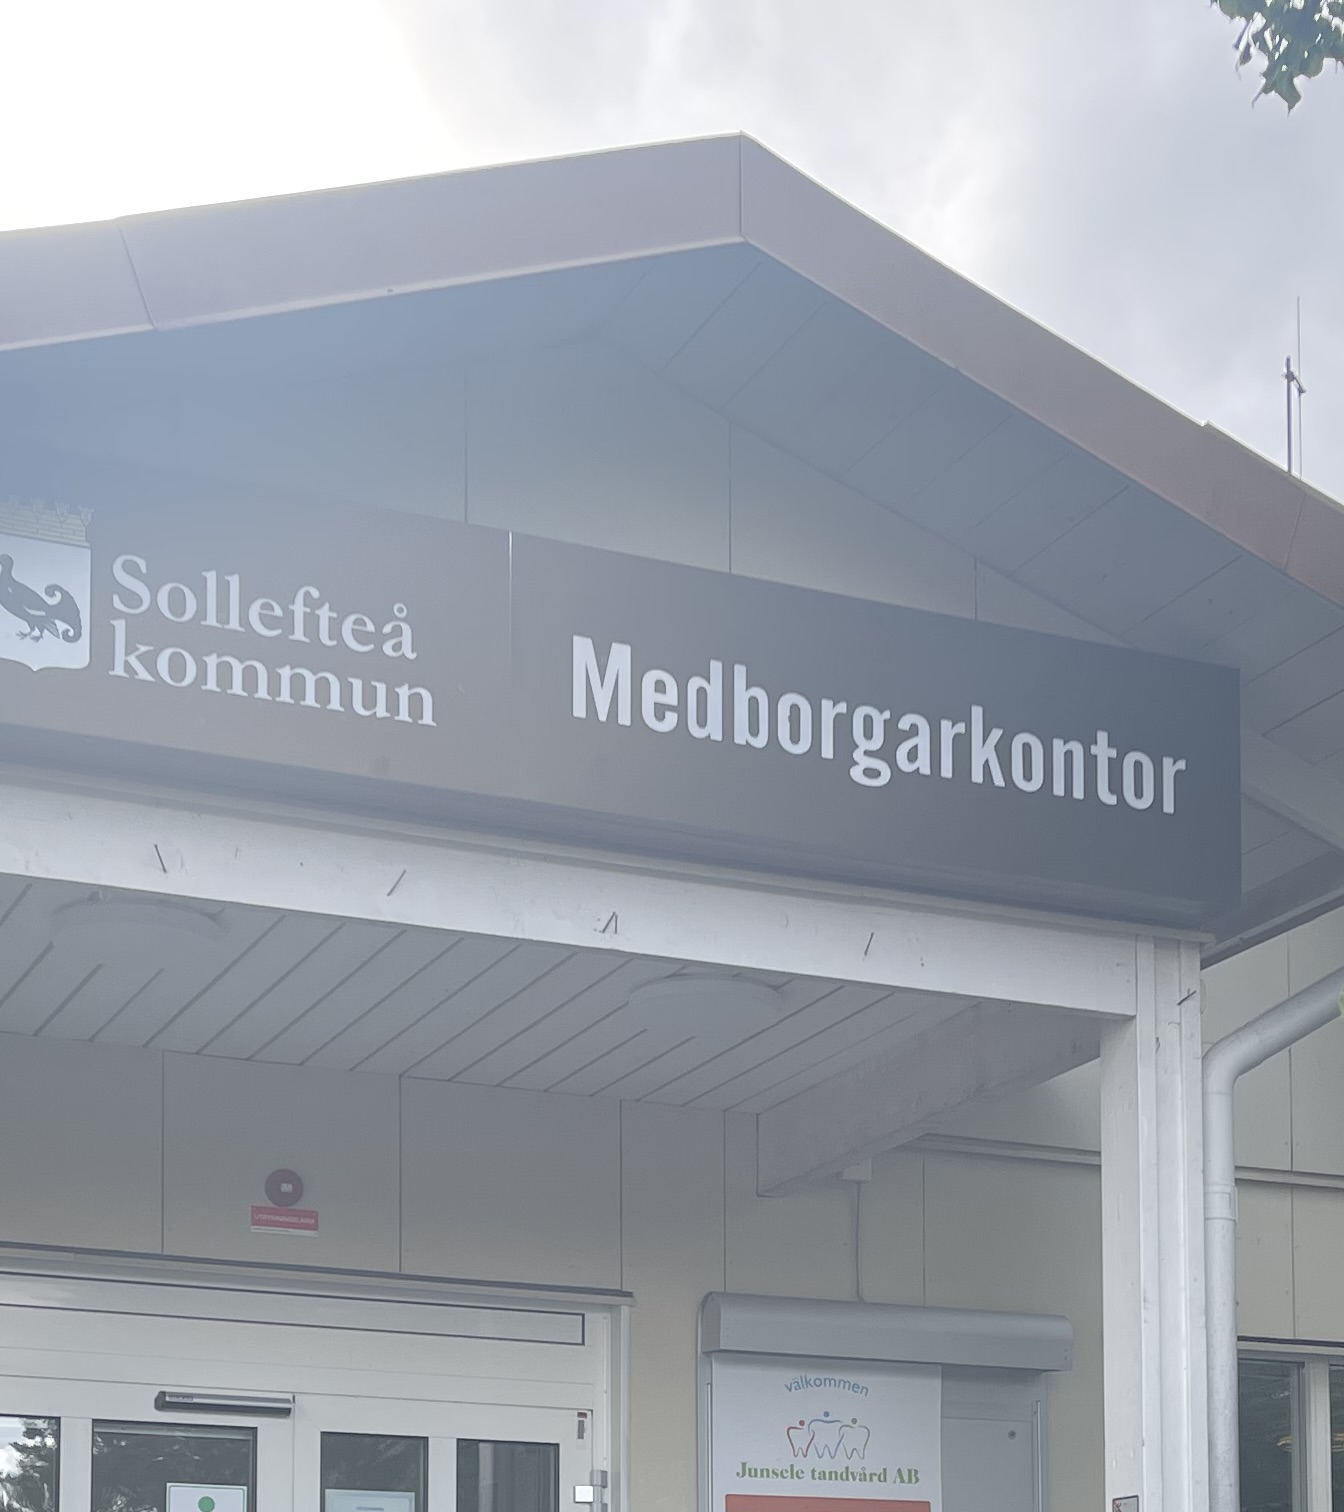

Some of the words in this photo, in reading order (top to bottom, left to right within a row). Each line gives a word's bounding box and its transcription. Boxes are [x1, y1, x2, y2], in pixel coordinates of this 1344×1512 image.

[110, 552, 418, 662] Sollefteå
[109, 618, 438, 730] kommun
[570, 634, 1187, 816] Medborgarkontor
[783, 1373, 870, 1397] välkommen
[736, 1461, 805, 1480] Junsele
[810, 1465, 888, 1483] tandvård
[892, 1467, 920, 1485] AB
